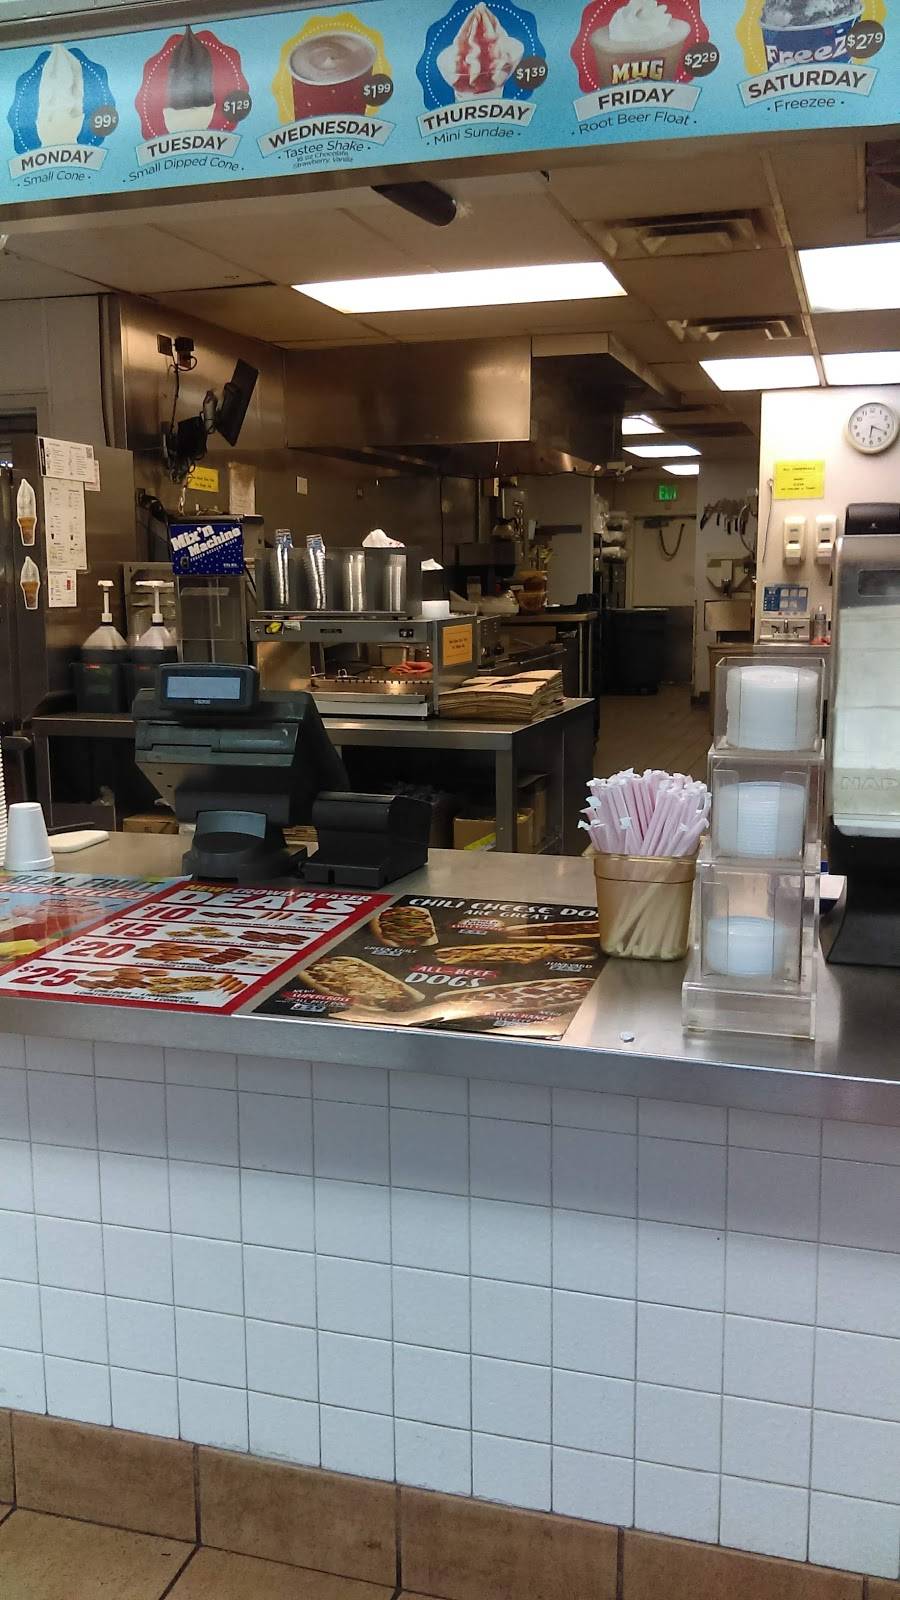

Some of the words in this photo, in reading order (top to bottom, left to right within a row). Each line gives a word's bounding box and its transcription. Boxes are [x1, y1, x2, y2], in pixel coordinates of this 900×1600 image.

[611, 59, 664, 84] MUG
[748, 69, 867, 99] SATURDAY
[598, 88, 675, 110] FRIDAY
[775, 97, 836, 112] Freezee
[424, 104, 530, 130] THURSDAY
[578, 117, 616, 135] Root
[617, 112, 651, 125] Beer
[654, 111, 690, 126] Float
[268, 120, 383, 148] WEDNESDAY
[434, 132, 460, 145] Mini
[463, 126, 514, 139] Sundae
[147, 135, 228, 157] TUESDAY
[284, 143, 323, 159] Tastee
[326, 140, 364, 152] Shake
[21, 149, 94, 171] MONDAY
[128, 162, 161, 182] Small
[164, 156, 208, 170] Dipped
[209, 157, 239, 172] Cone
[23, 171, 54, 187] Small
[56, 170, 85, 181] Cone
[188, 527, 241, 557] Machine
[77, 877, 168, 891] FRUIT
[161, 890, 364, 914] DEALS
[234, 888, 294, 897] CROWD
[297, 891, 373, 902] PLEASER
[143, 904, 197, 920] $10
[408, 898, 465, 909] CHILI
[470, 902, 555, 914] CHEESE
[499, 911, 556, 920] GREAT
[109, 921, 167, 938] $15
[62, 940, 137, 959] $20
[9, 965, 89, 987] $25
[404, 972, 486, 987] DOGS
